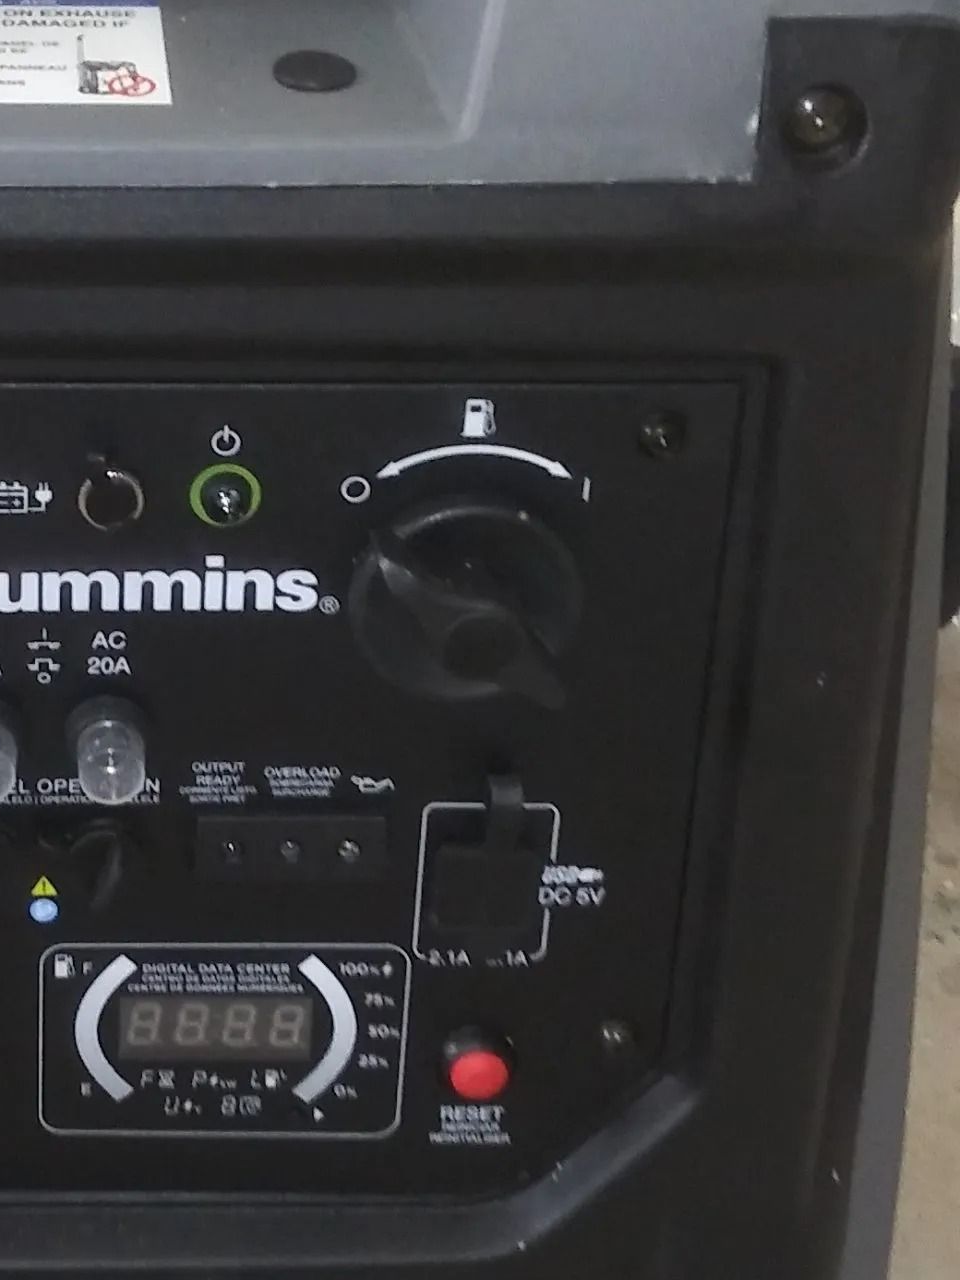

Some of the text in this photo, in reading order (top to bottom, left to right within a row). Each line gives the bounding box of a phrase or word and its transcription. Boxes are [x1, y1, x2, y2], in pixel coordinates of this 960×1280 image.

[3, 9, 33, 17] ON
[2, 19, 106, 28] DAMAGED
[91, 630, 128, 650] AC
[87, 657, 132, 676] 20A
[191, 761, 246, 773] OUTPUT
[264, 766, 341, 778] OVERLOAD
[195, 774, 241, 785] READY
[142, 963, 290, 974] DIGITAL DATA CENTER
[440, 1105, 505, 1121] RESET
